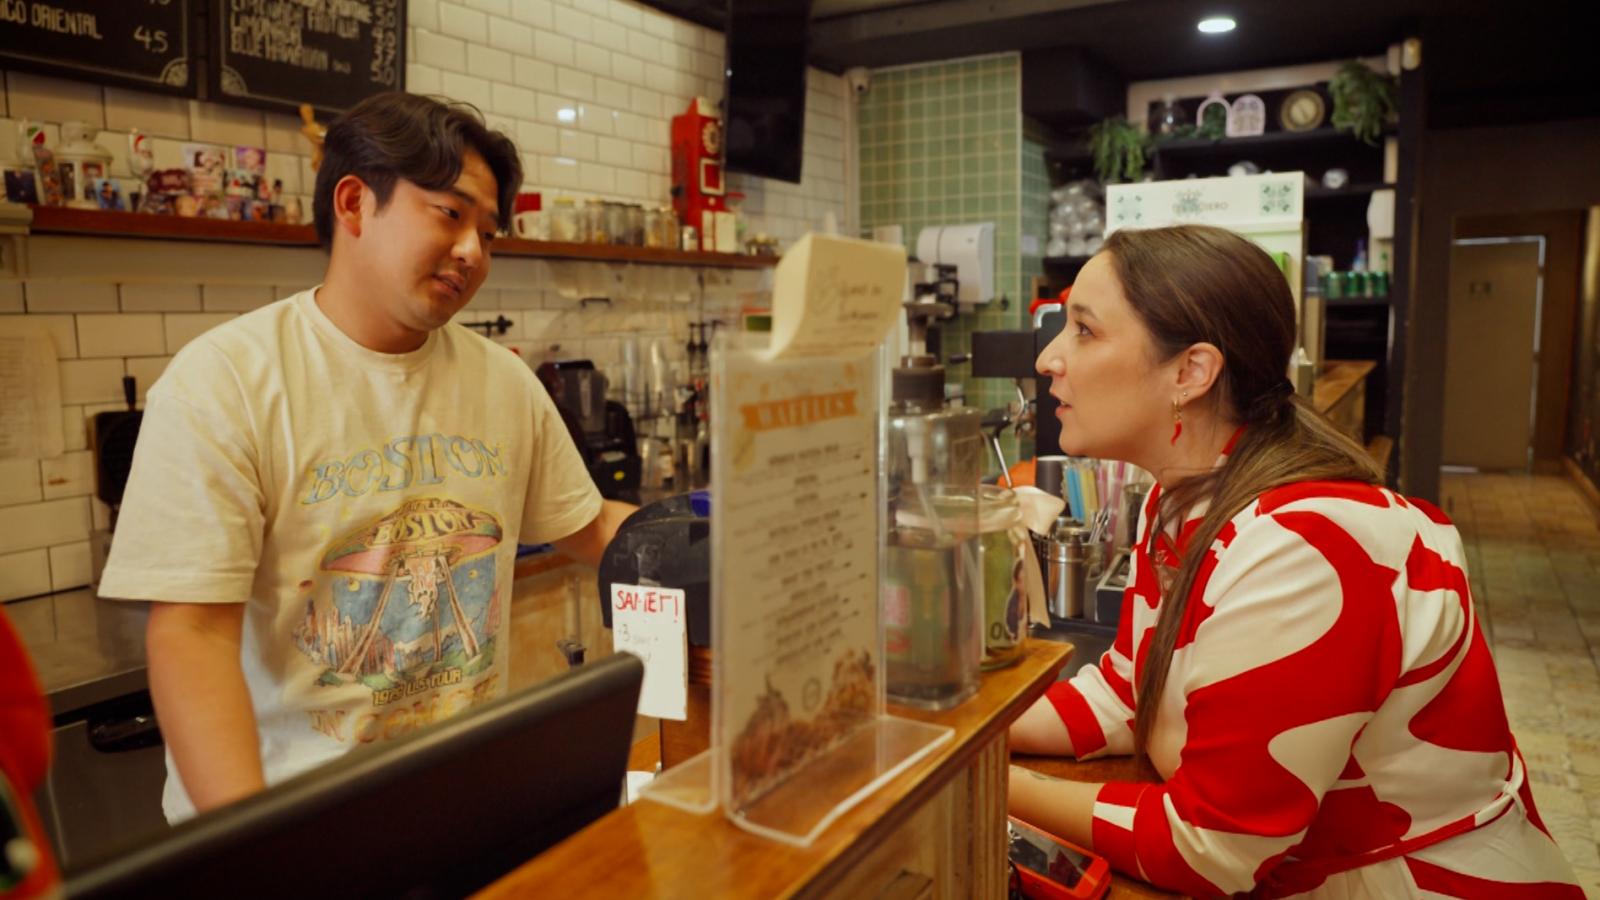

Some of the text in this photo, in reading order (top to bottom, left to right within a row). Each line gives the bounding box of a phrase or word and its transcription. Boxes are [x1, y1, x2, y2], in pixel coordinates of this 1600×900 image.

[31, 3, 103, 39] ORIENTAL
[134, 25, 168, 53] 45
[301, 433, 507, 505] BOSTON
[373, 508, 475, 545] BOSTON
